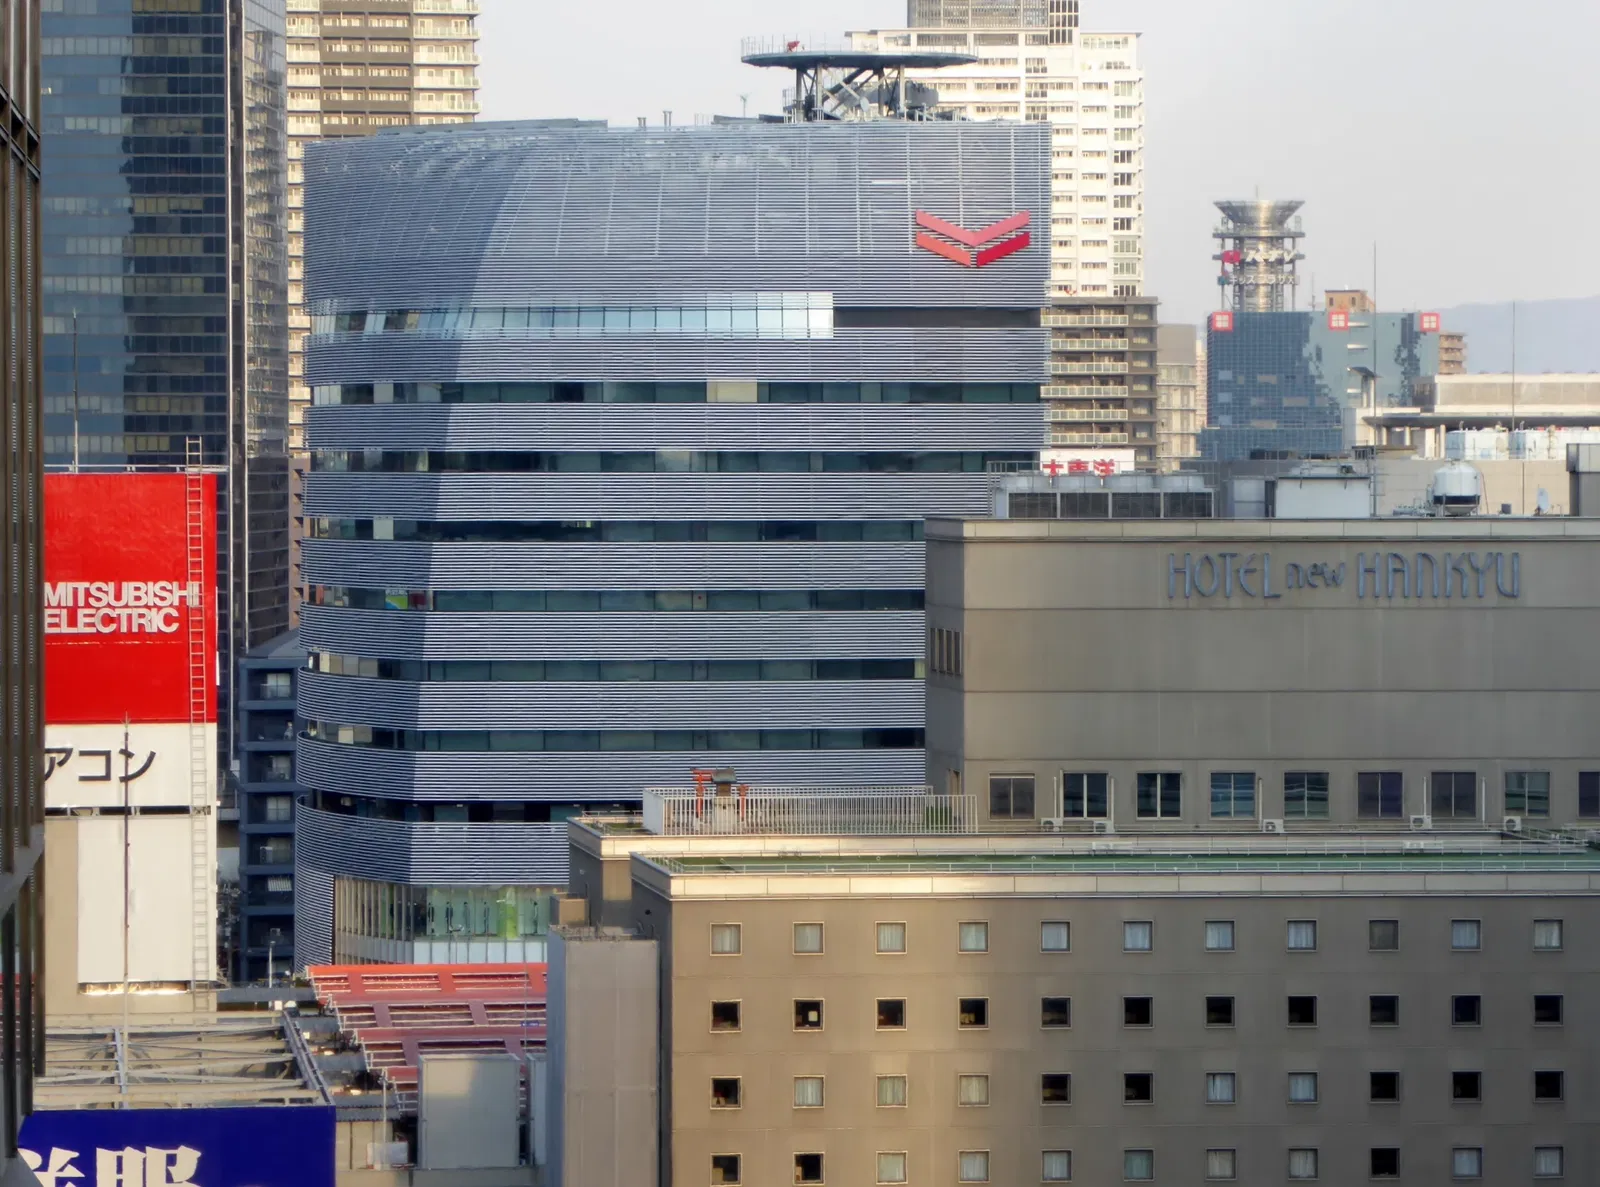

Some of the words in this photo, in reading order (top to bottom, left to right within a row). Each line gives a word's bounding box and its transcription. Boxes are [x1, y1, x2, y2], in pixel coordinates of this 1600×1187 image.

[1167, 552, 1283, 598] HOTEL
[1287, 561, 1346, 589] new
[1356, 551, 1520, 598] HANKYU
[44, 581, 200, 607] MITSUBISHI
[44, 608, 180, 634] ELECTRIC
